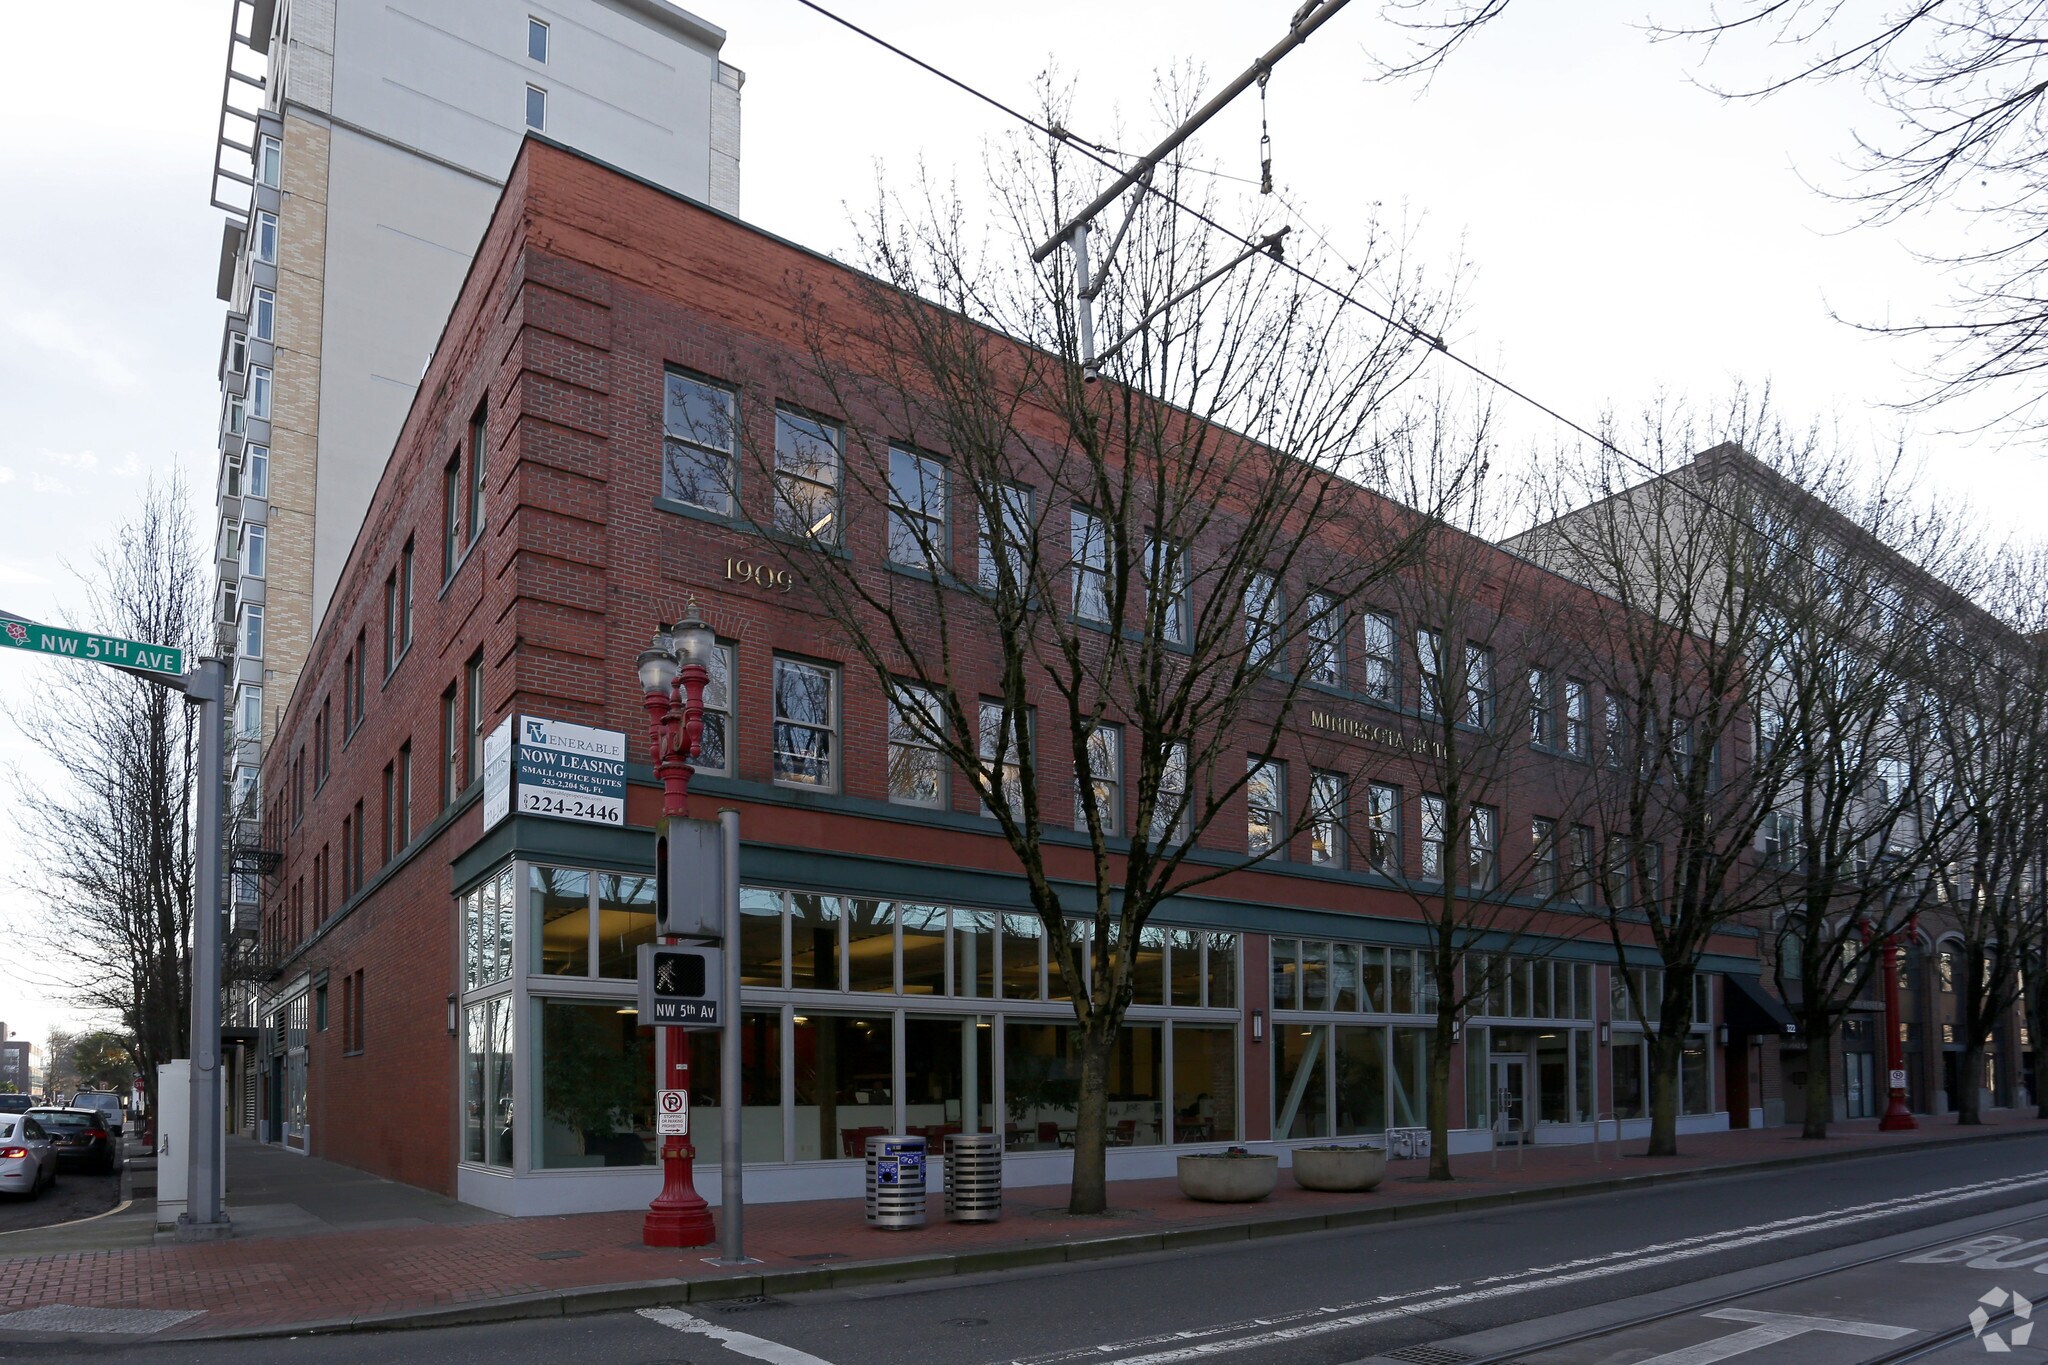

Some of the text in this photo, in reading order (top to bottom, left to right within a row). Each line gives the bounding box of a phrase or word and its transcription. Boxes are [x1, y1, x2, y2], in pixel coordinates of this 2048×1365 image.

[724, 557, 792, 593] 1909
[41, 634, 174, 671] NW 5TH AVE
[1310, 710, 1405, 748] MINNESOTA
[520, 748, 557, 765] NOW
[560, 754, 625, 777] LEASING
[522, 765, 622, 788] SMALL OFFICE SUITES
[579, 784, 591, 794] Sq.
[593, 784, 604, 794] Ft.
[529, 795, 619, 822] 224-2446
[656, 1003, 715, 1018] NW 5th Av
